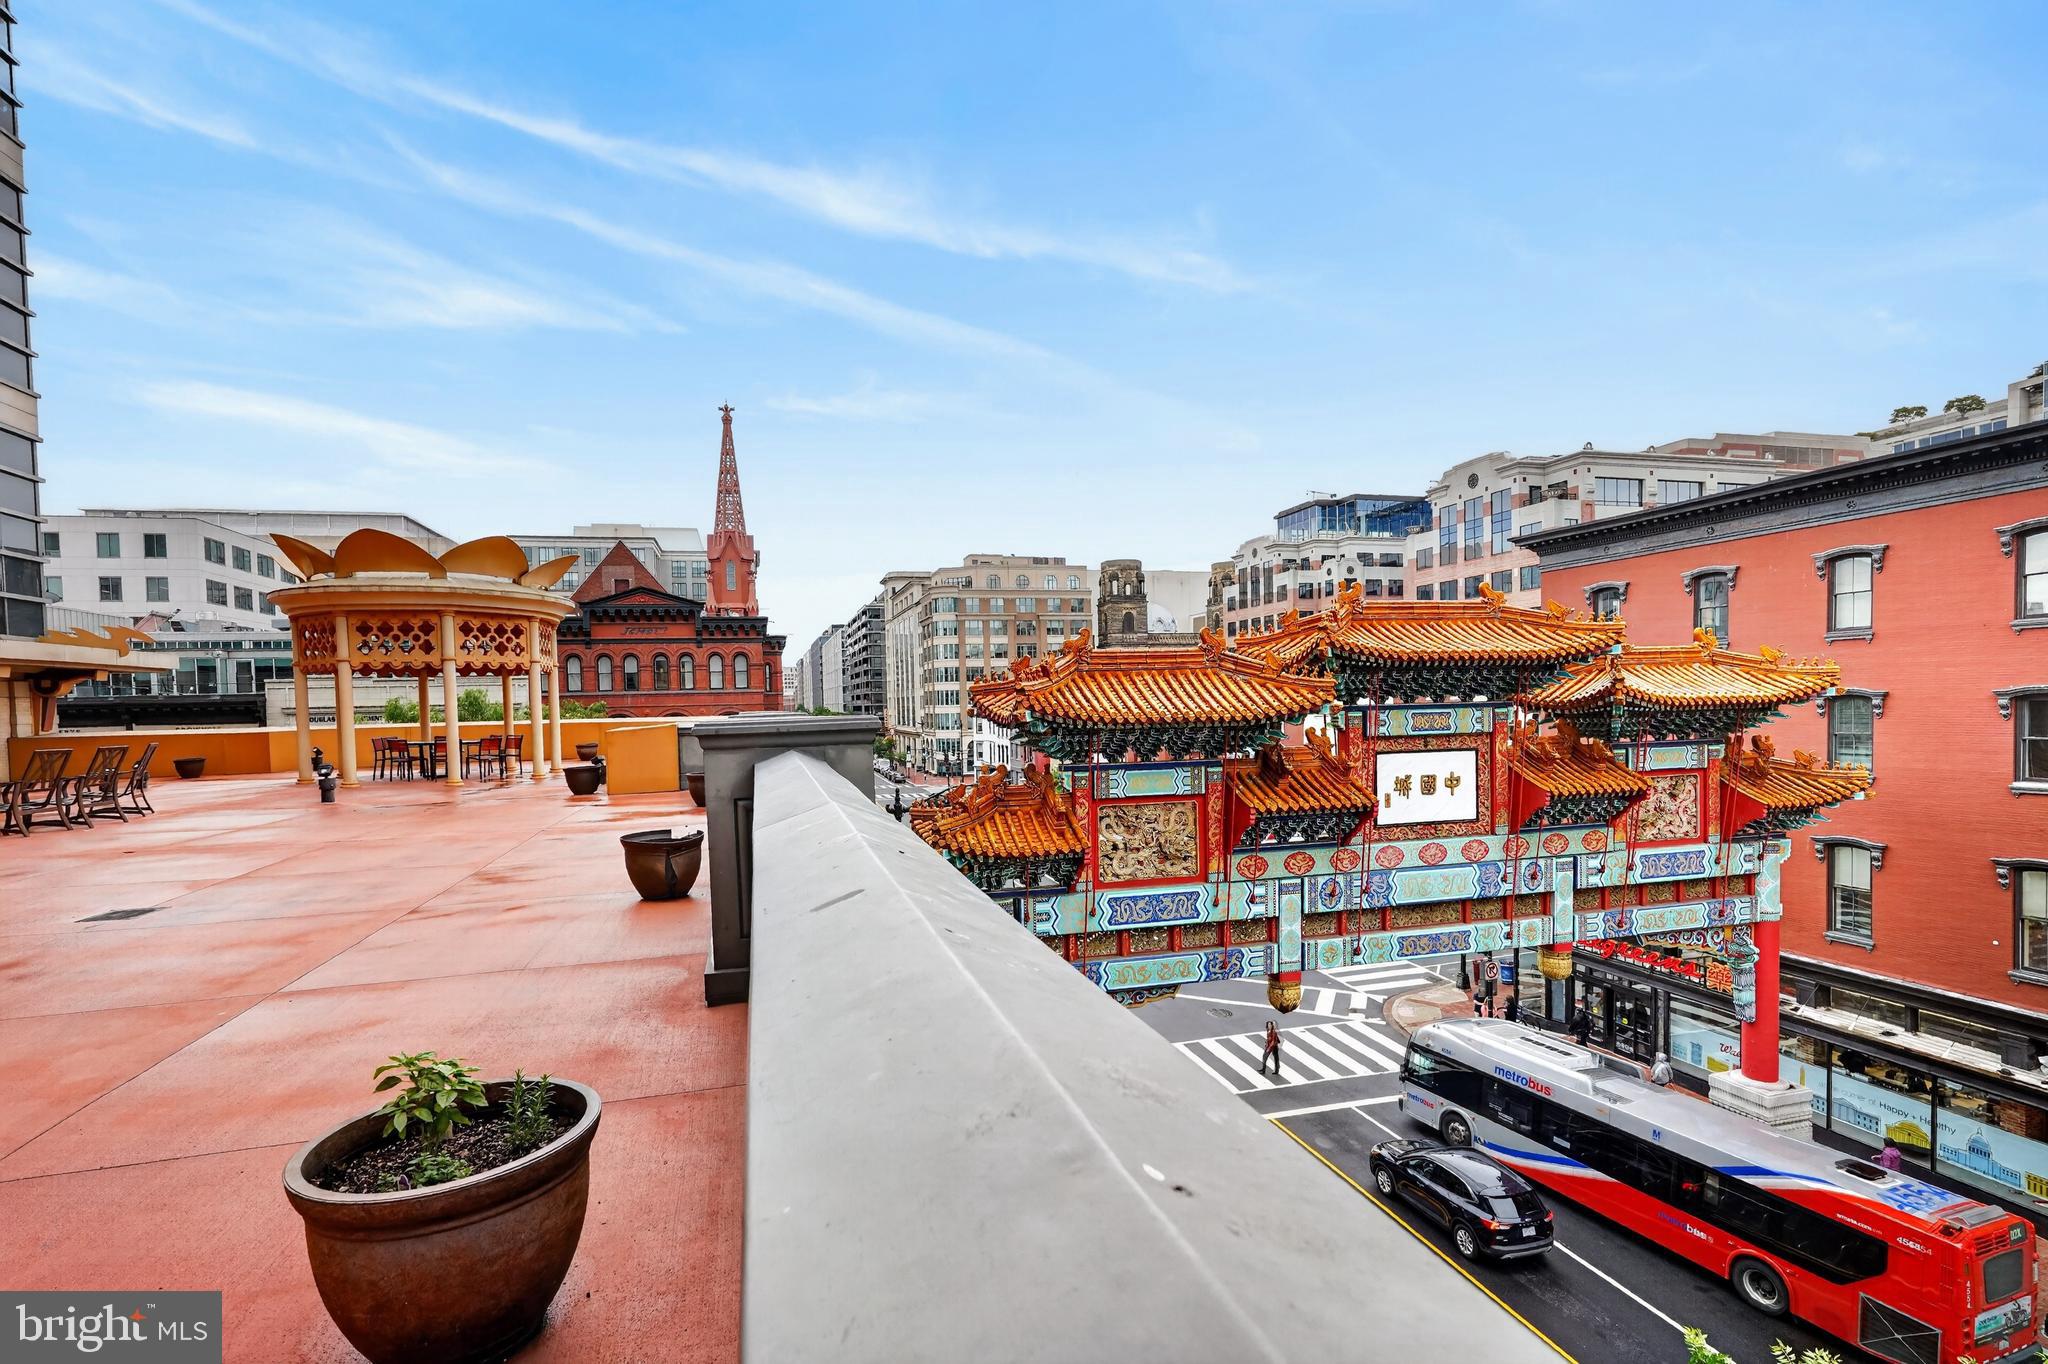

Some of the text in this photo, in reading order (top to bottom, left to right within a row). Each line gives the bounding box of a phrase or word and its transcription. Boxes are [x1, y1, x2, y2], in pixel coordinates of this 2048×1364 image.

[1494, 1065, 1552, 1096] metrobus
[1406, 1092, 1436, 1109] metrobus
[1879, 1101, 1910, 1120] Happy
